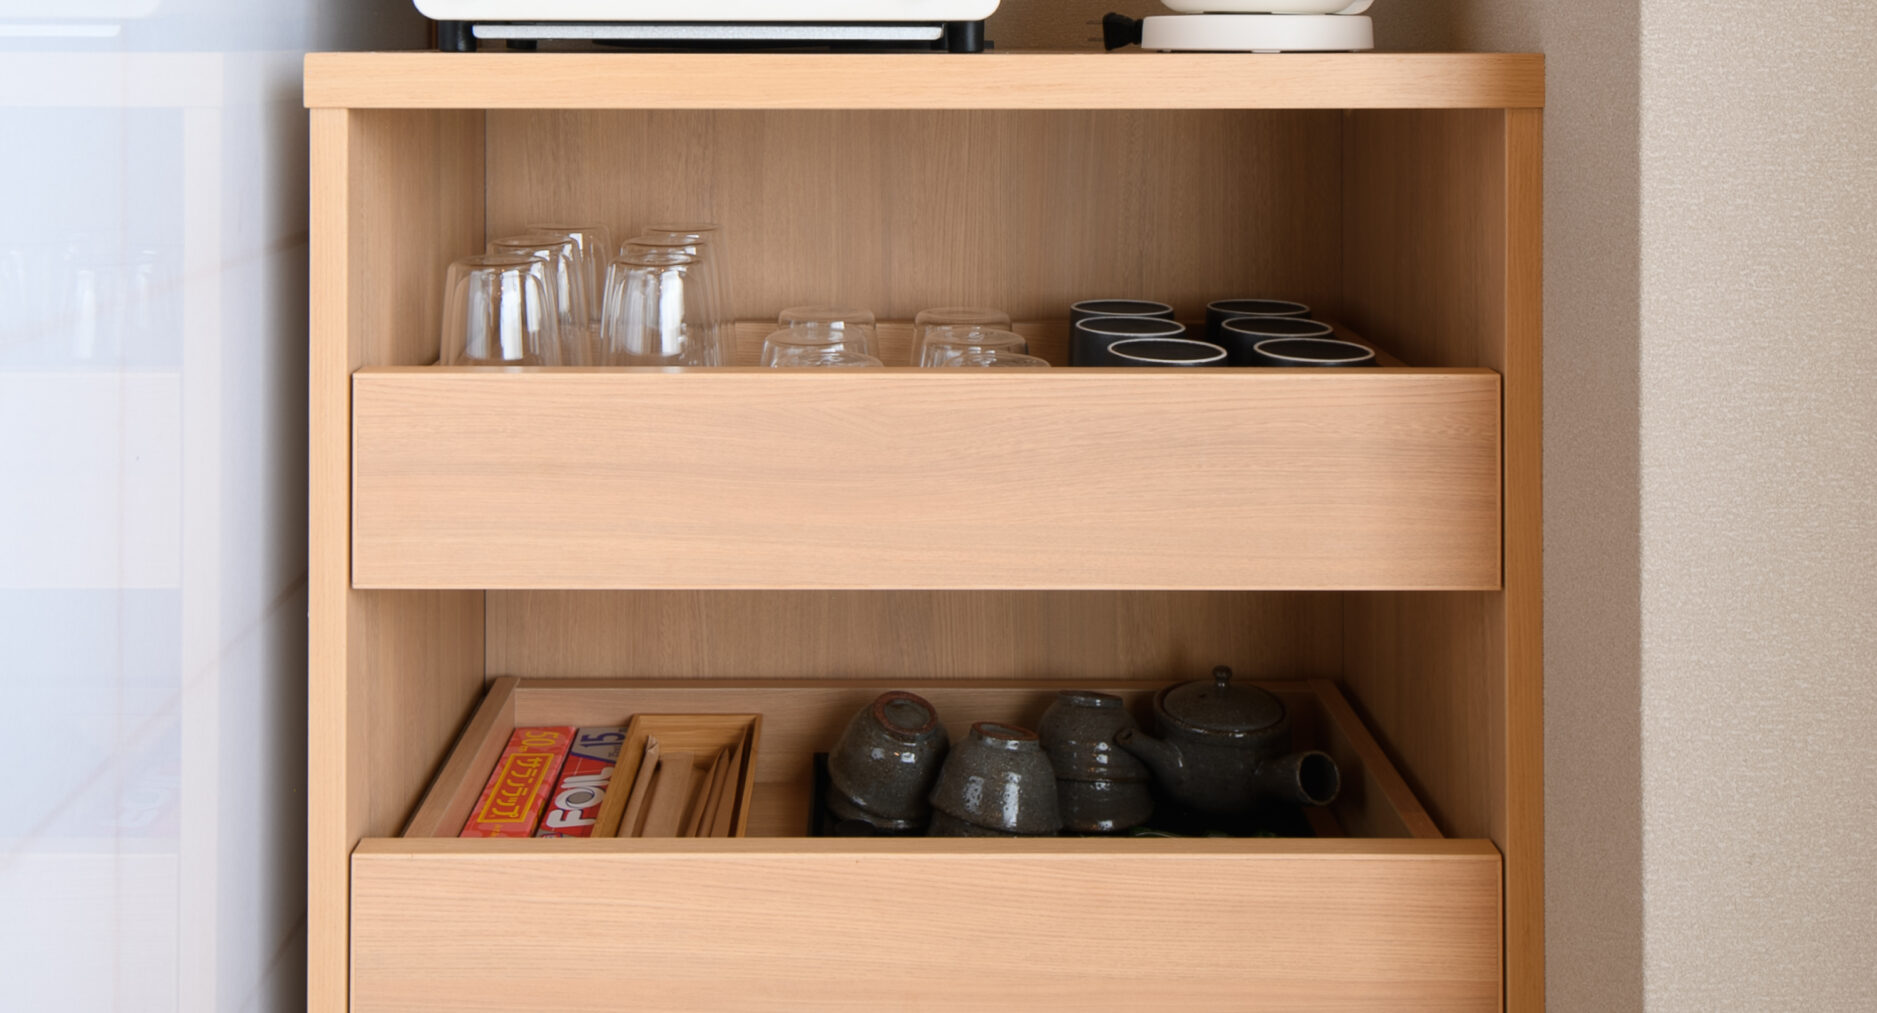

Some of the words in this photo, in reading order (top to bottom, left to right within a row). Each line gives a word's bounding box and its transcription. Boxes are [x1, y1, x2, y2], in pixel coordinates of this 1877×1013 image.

[492, 757, 543, 818] サランラップ
[546, 766, 616, 828] FOIL
